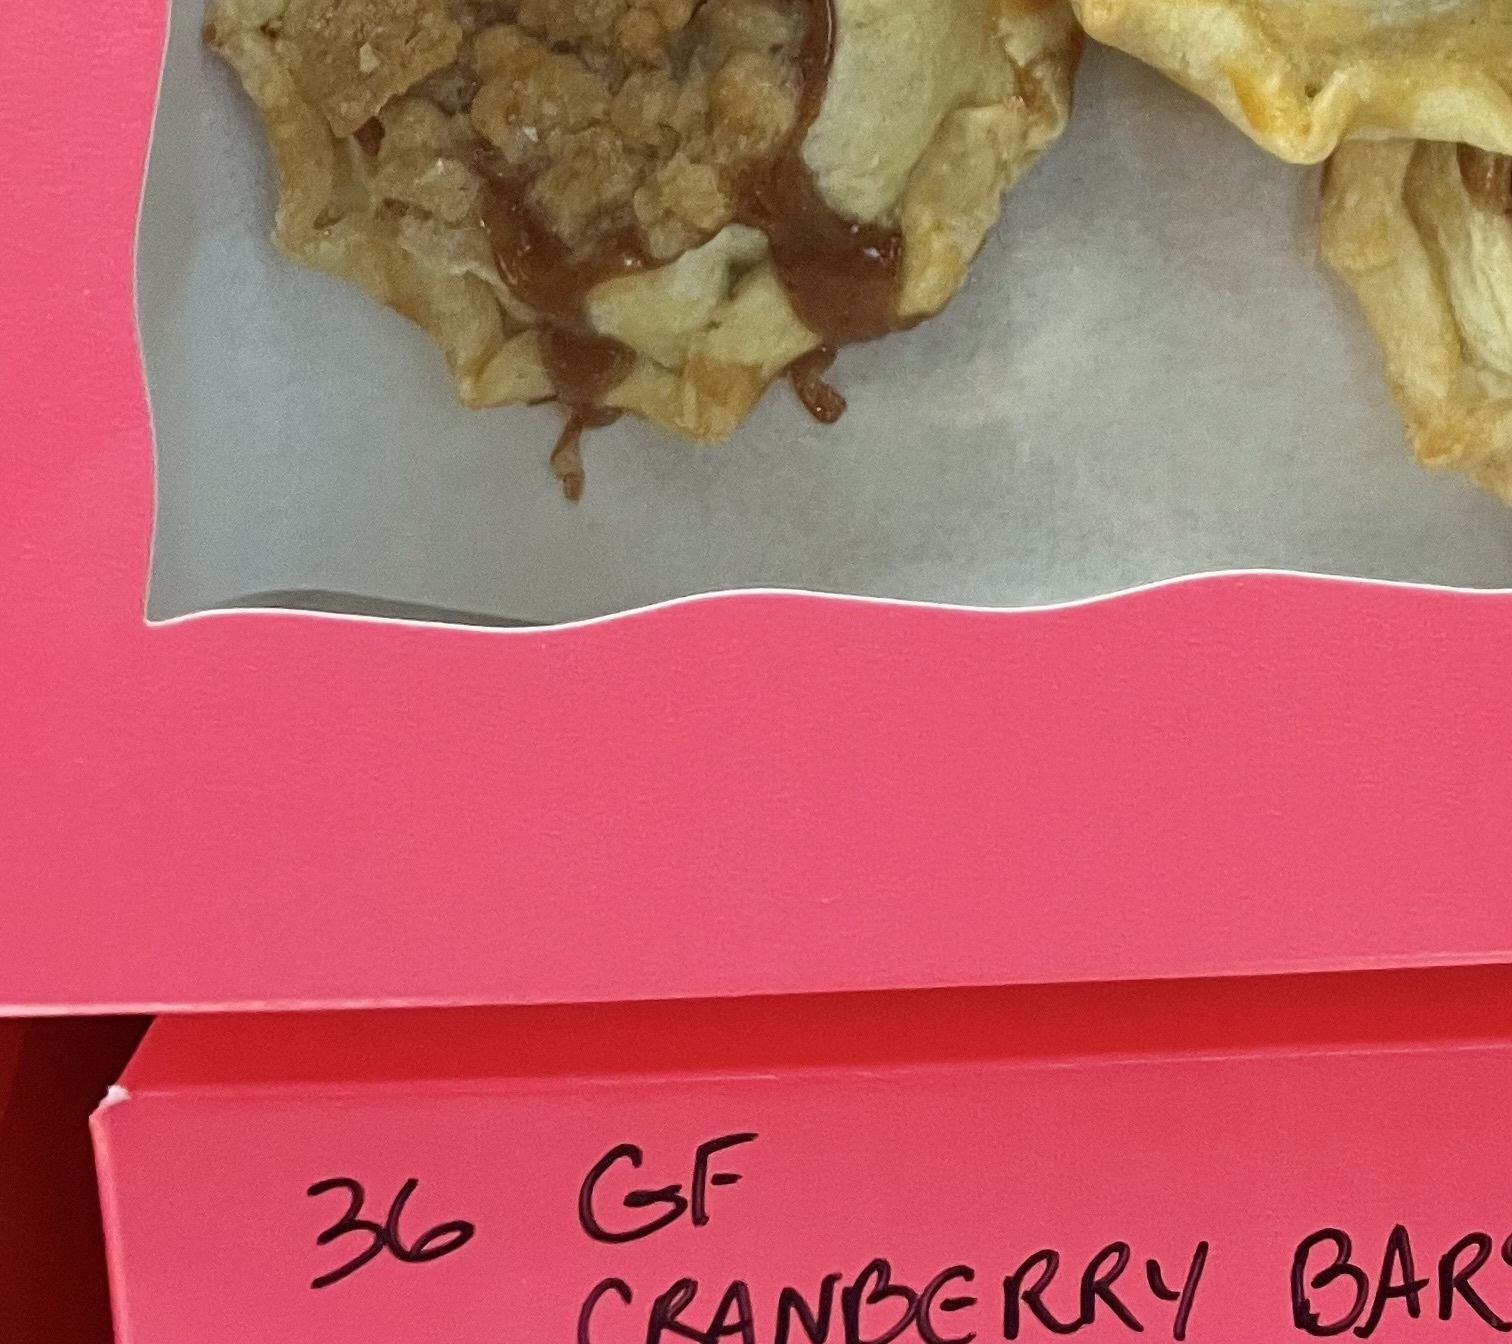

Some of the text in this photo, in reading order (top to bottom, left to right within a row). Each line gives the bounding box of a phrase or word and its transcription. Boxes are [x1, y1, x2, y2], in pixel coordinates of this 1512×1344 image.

[306, 1132, 759, 1290] 36 GF
[577, 1241, 1209, 1344] CRANBERRY
